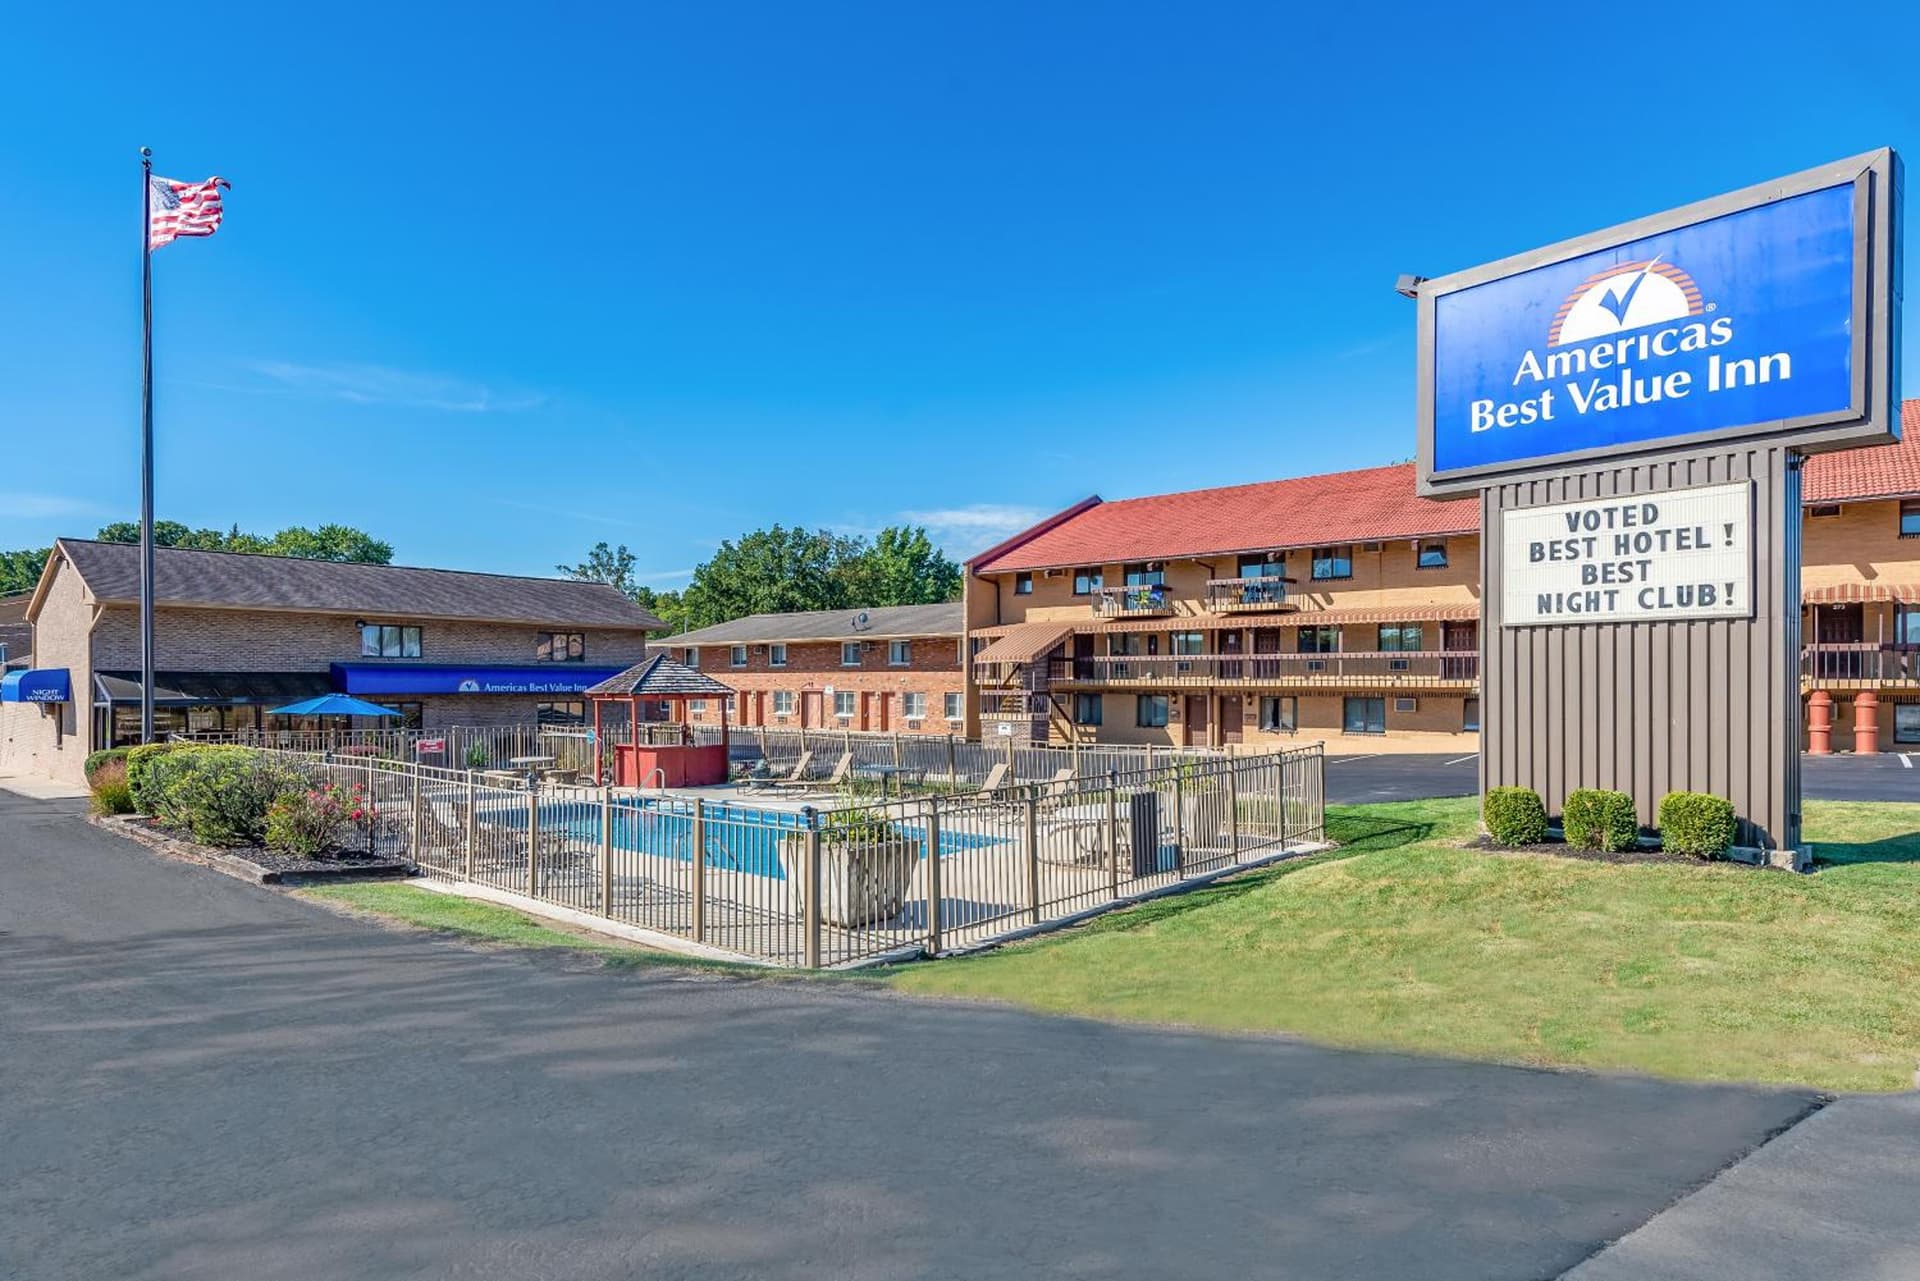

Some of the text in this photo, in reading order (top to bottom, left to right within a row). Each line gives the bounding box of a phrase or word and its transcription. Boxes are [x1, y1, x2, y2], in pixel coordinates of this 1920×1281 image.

[1512, 316, 1734, 386] Americas
[1471, 351, 1791, 433] Best Value Inn
[1565, 503, 1659, 533] VOTED
[1529, 536, 1597, 563] BEST
[1581, 559, 1652, 585] BEST
[1537, 589, 1619, 615] NIGHT
[484, 682, 527, 692] Americas
[530, 682, 548, 692] Best
[549, 682, 573, 692] Value
